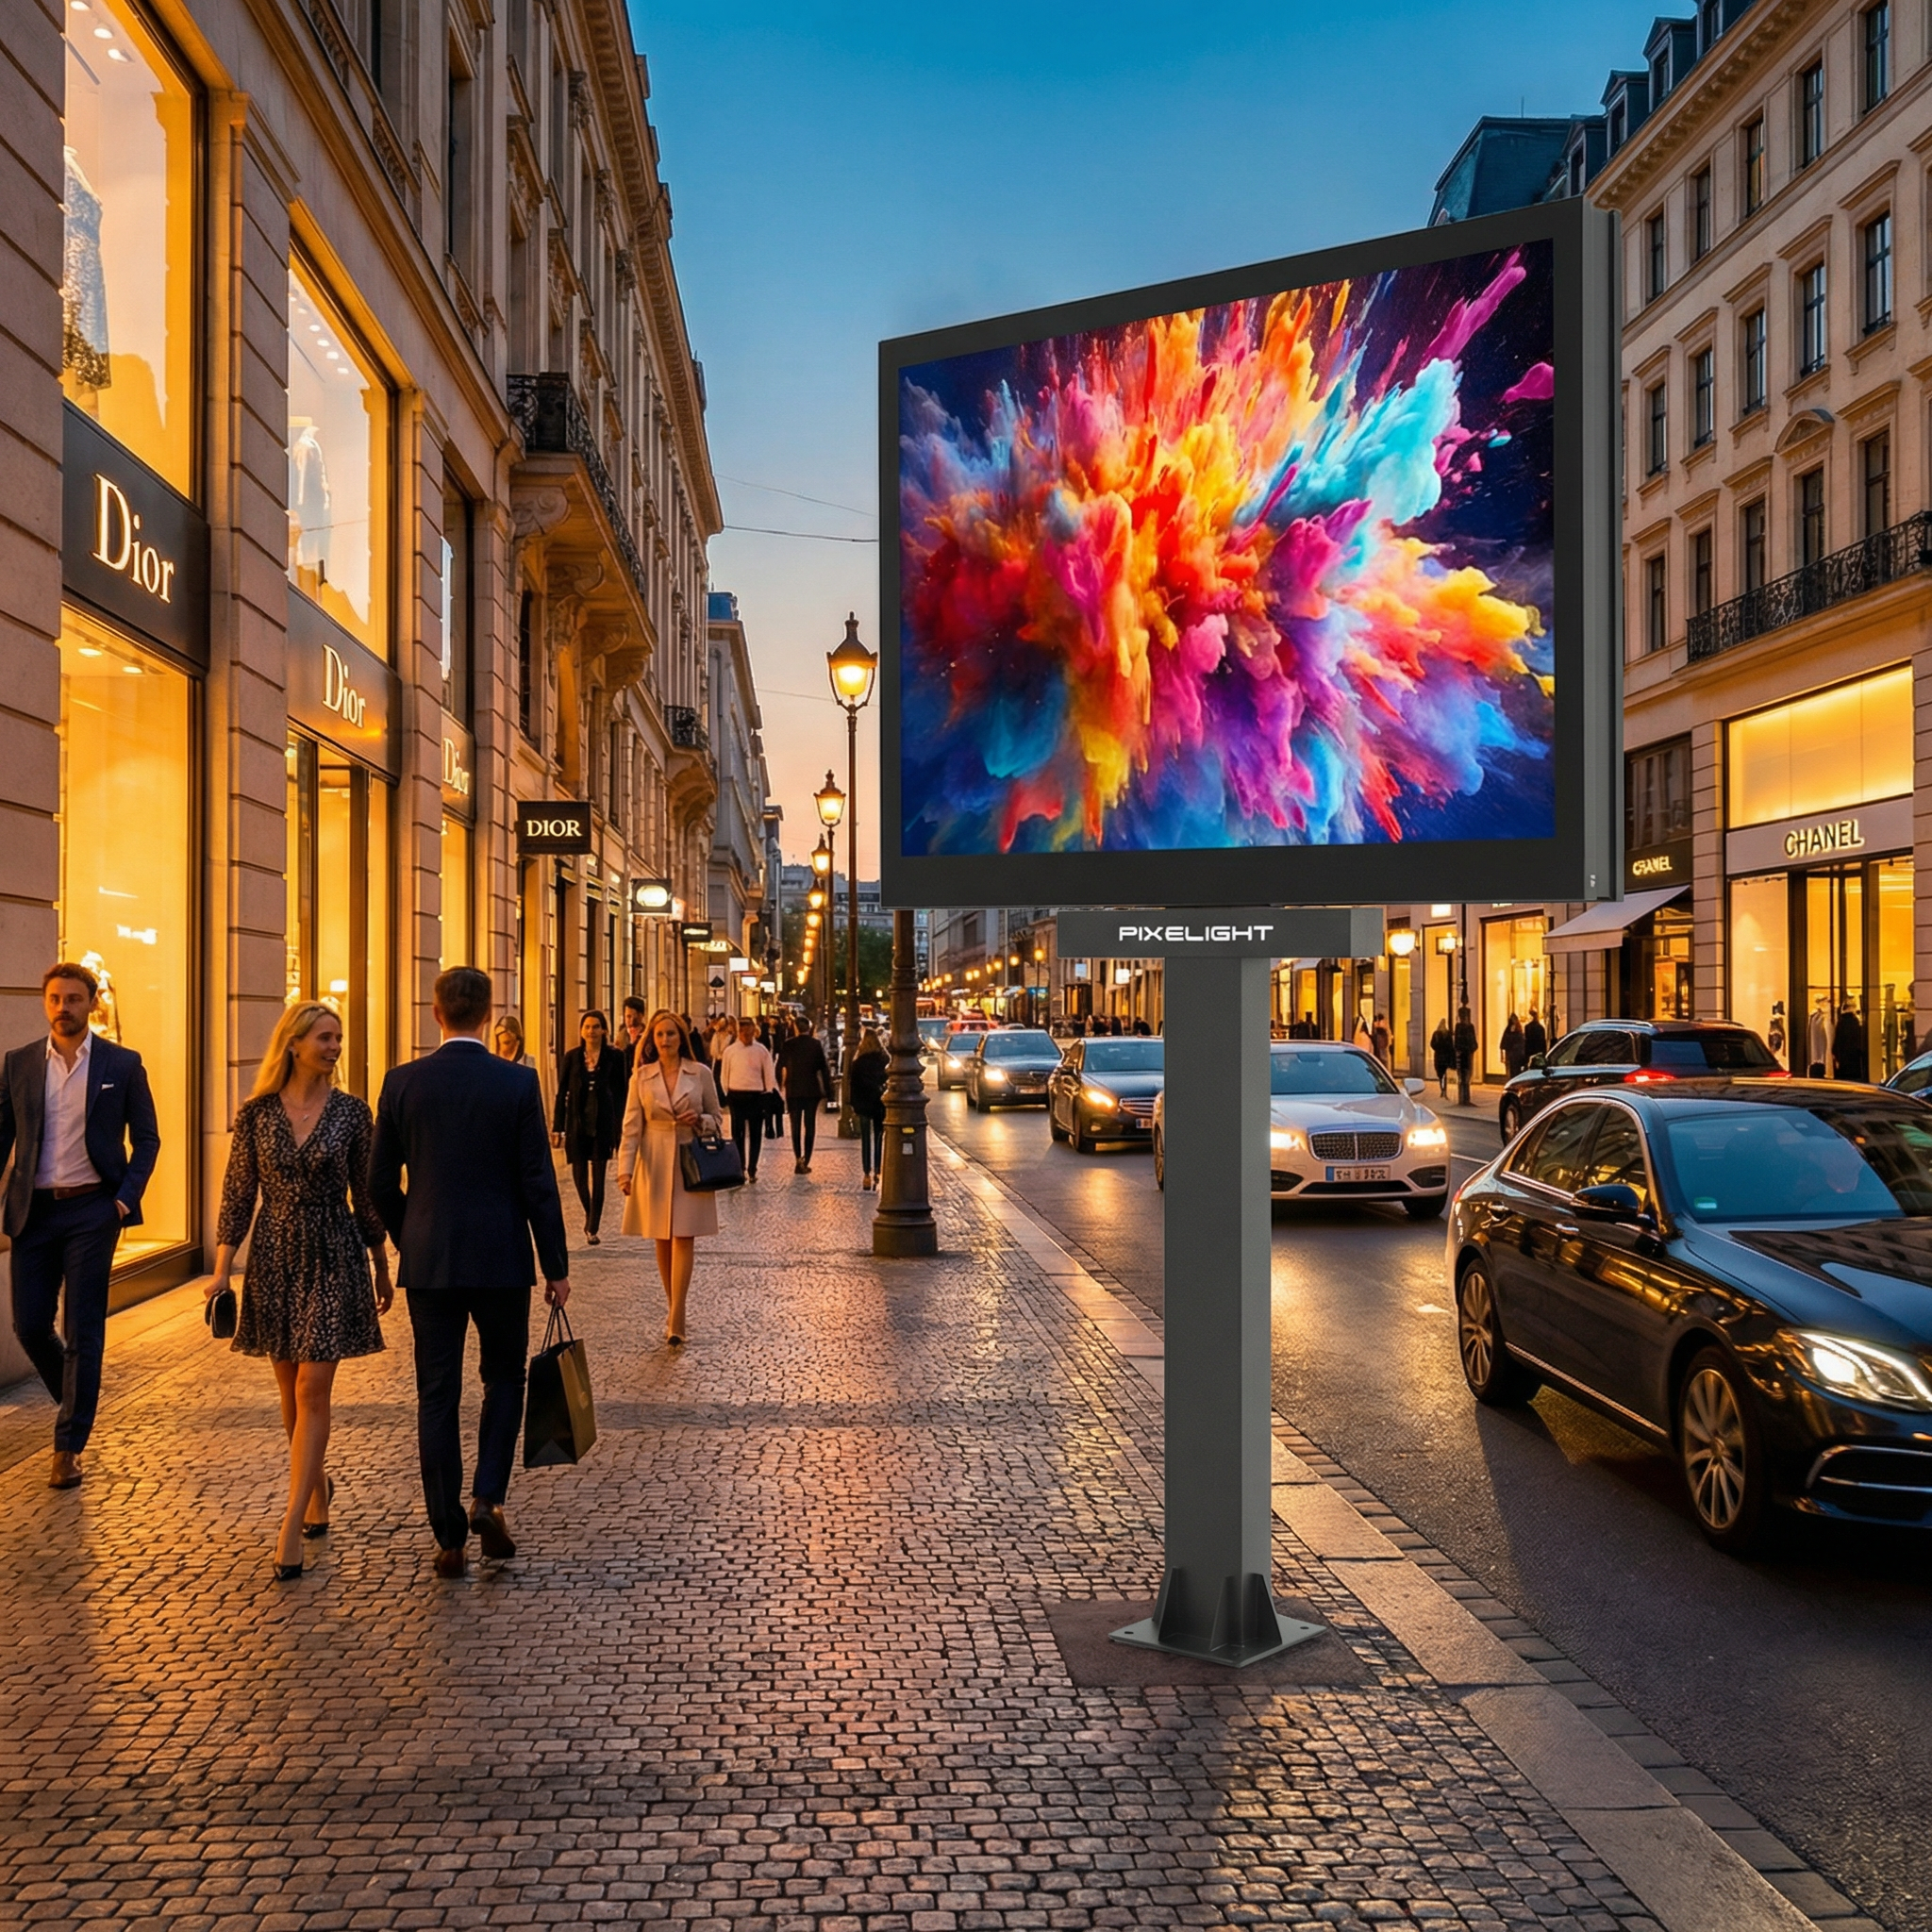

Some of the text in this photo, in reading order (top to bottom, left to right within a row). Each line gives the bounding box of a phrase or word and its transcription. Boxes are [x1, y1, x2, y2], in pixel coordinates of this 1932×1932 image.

[92, 474, 175, 604] Dior
[322, 643, 366, 727] Dior
[526, 819, 583, 837] DIOR
[1784, 819, 1865, 858] CHANEL
[1119, 925, 1274, 941] PIXELIGHT
